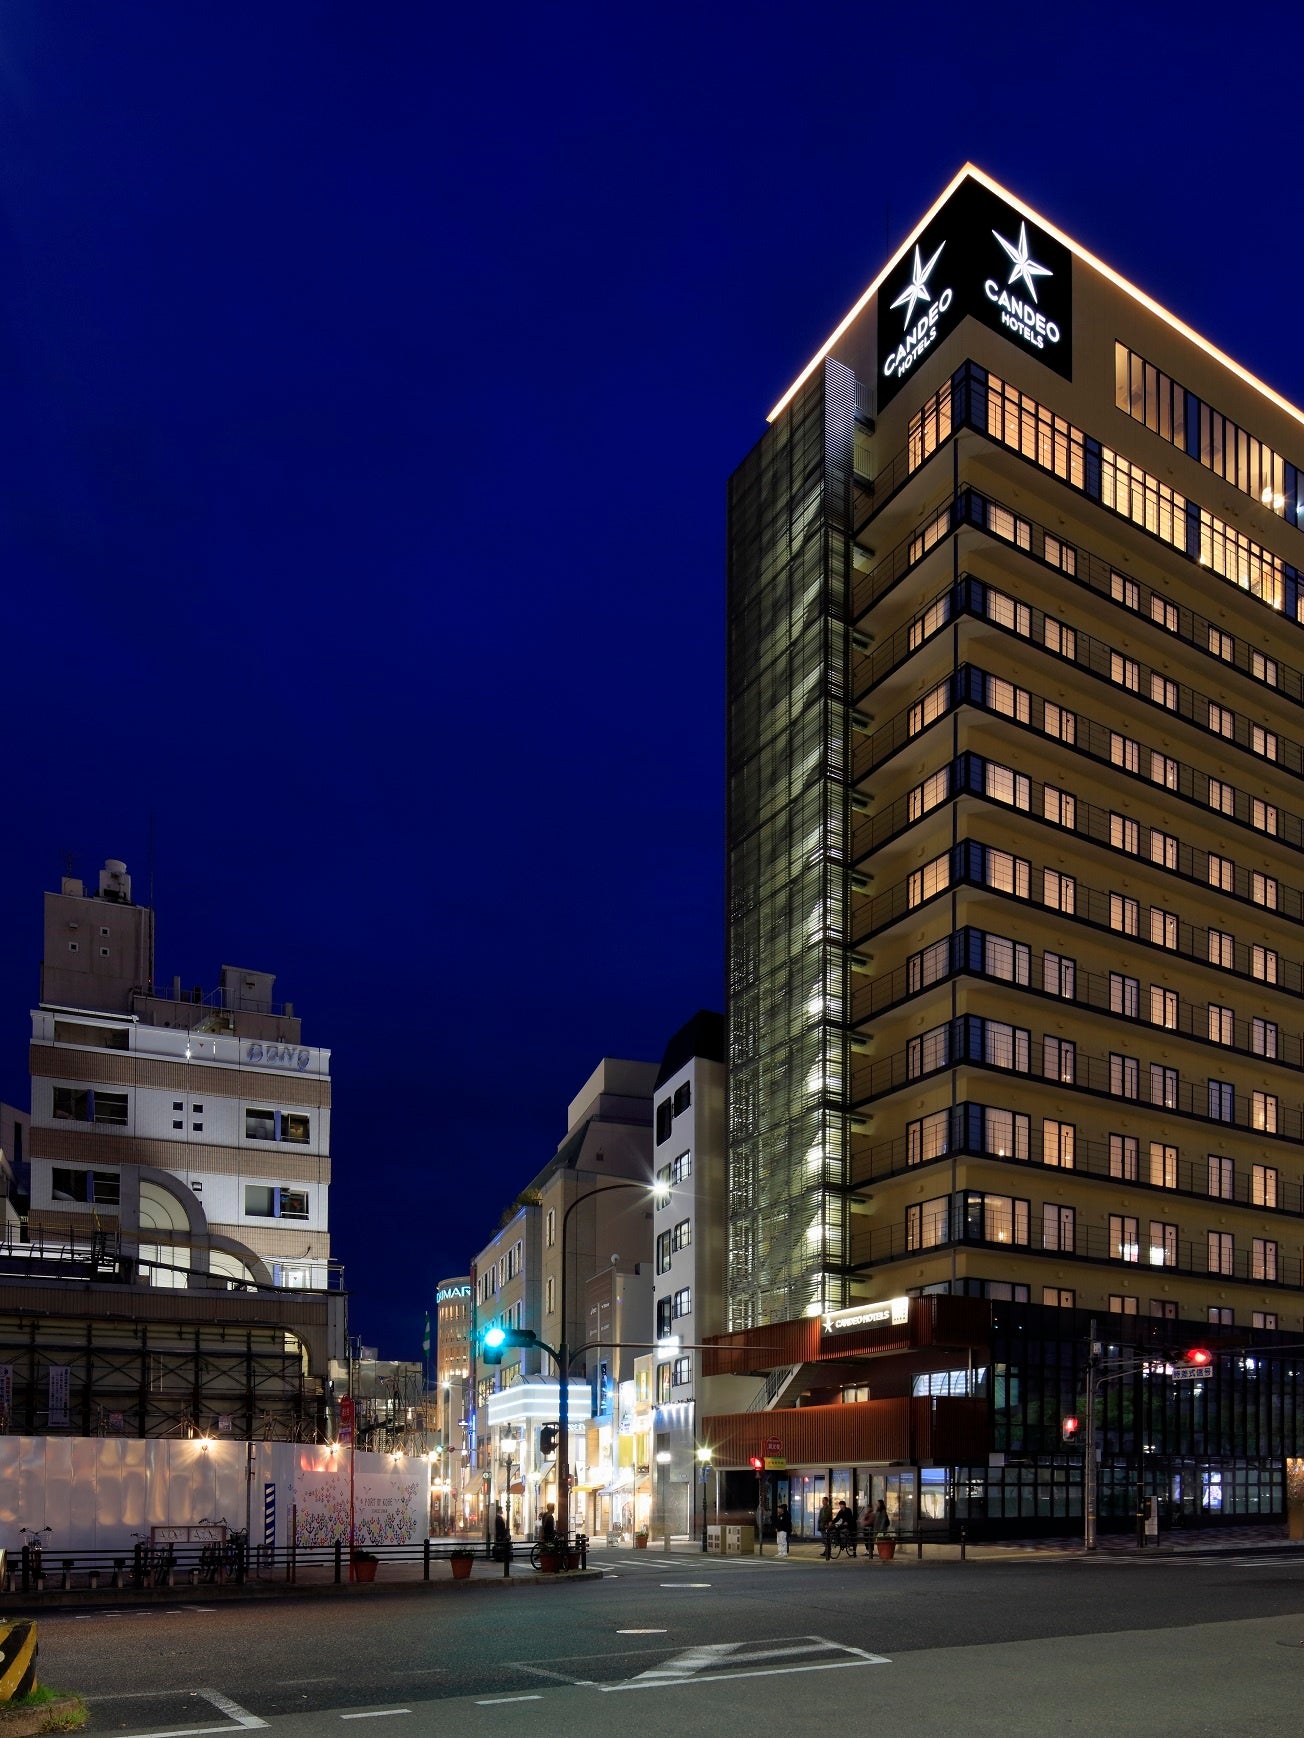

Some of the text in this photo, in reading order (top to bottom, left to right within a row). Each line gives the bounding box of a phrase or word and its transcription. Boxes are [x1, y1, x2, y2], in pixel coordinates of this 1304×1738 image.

[884, 288, 953, 376] CANDEO
[985, 279, 1060, 343] CANDEO
[1001, 310, 1044, 349] HOTELS
[898, 326, 937, 377] HOTELS
[835, 1310, 890, 1329] CANDEO HOTELS
